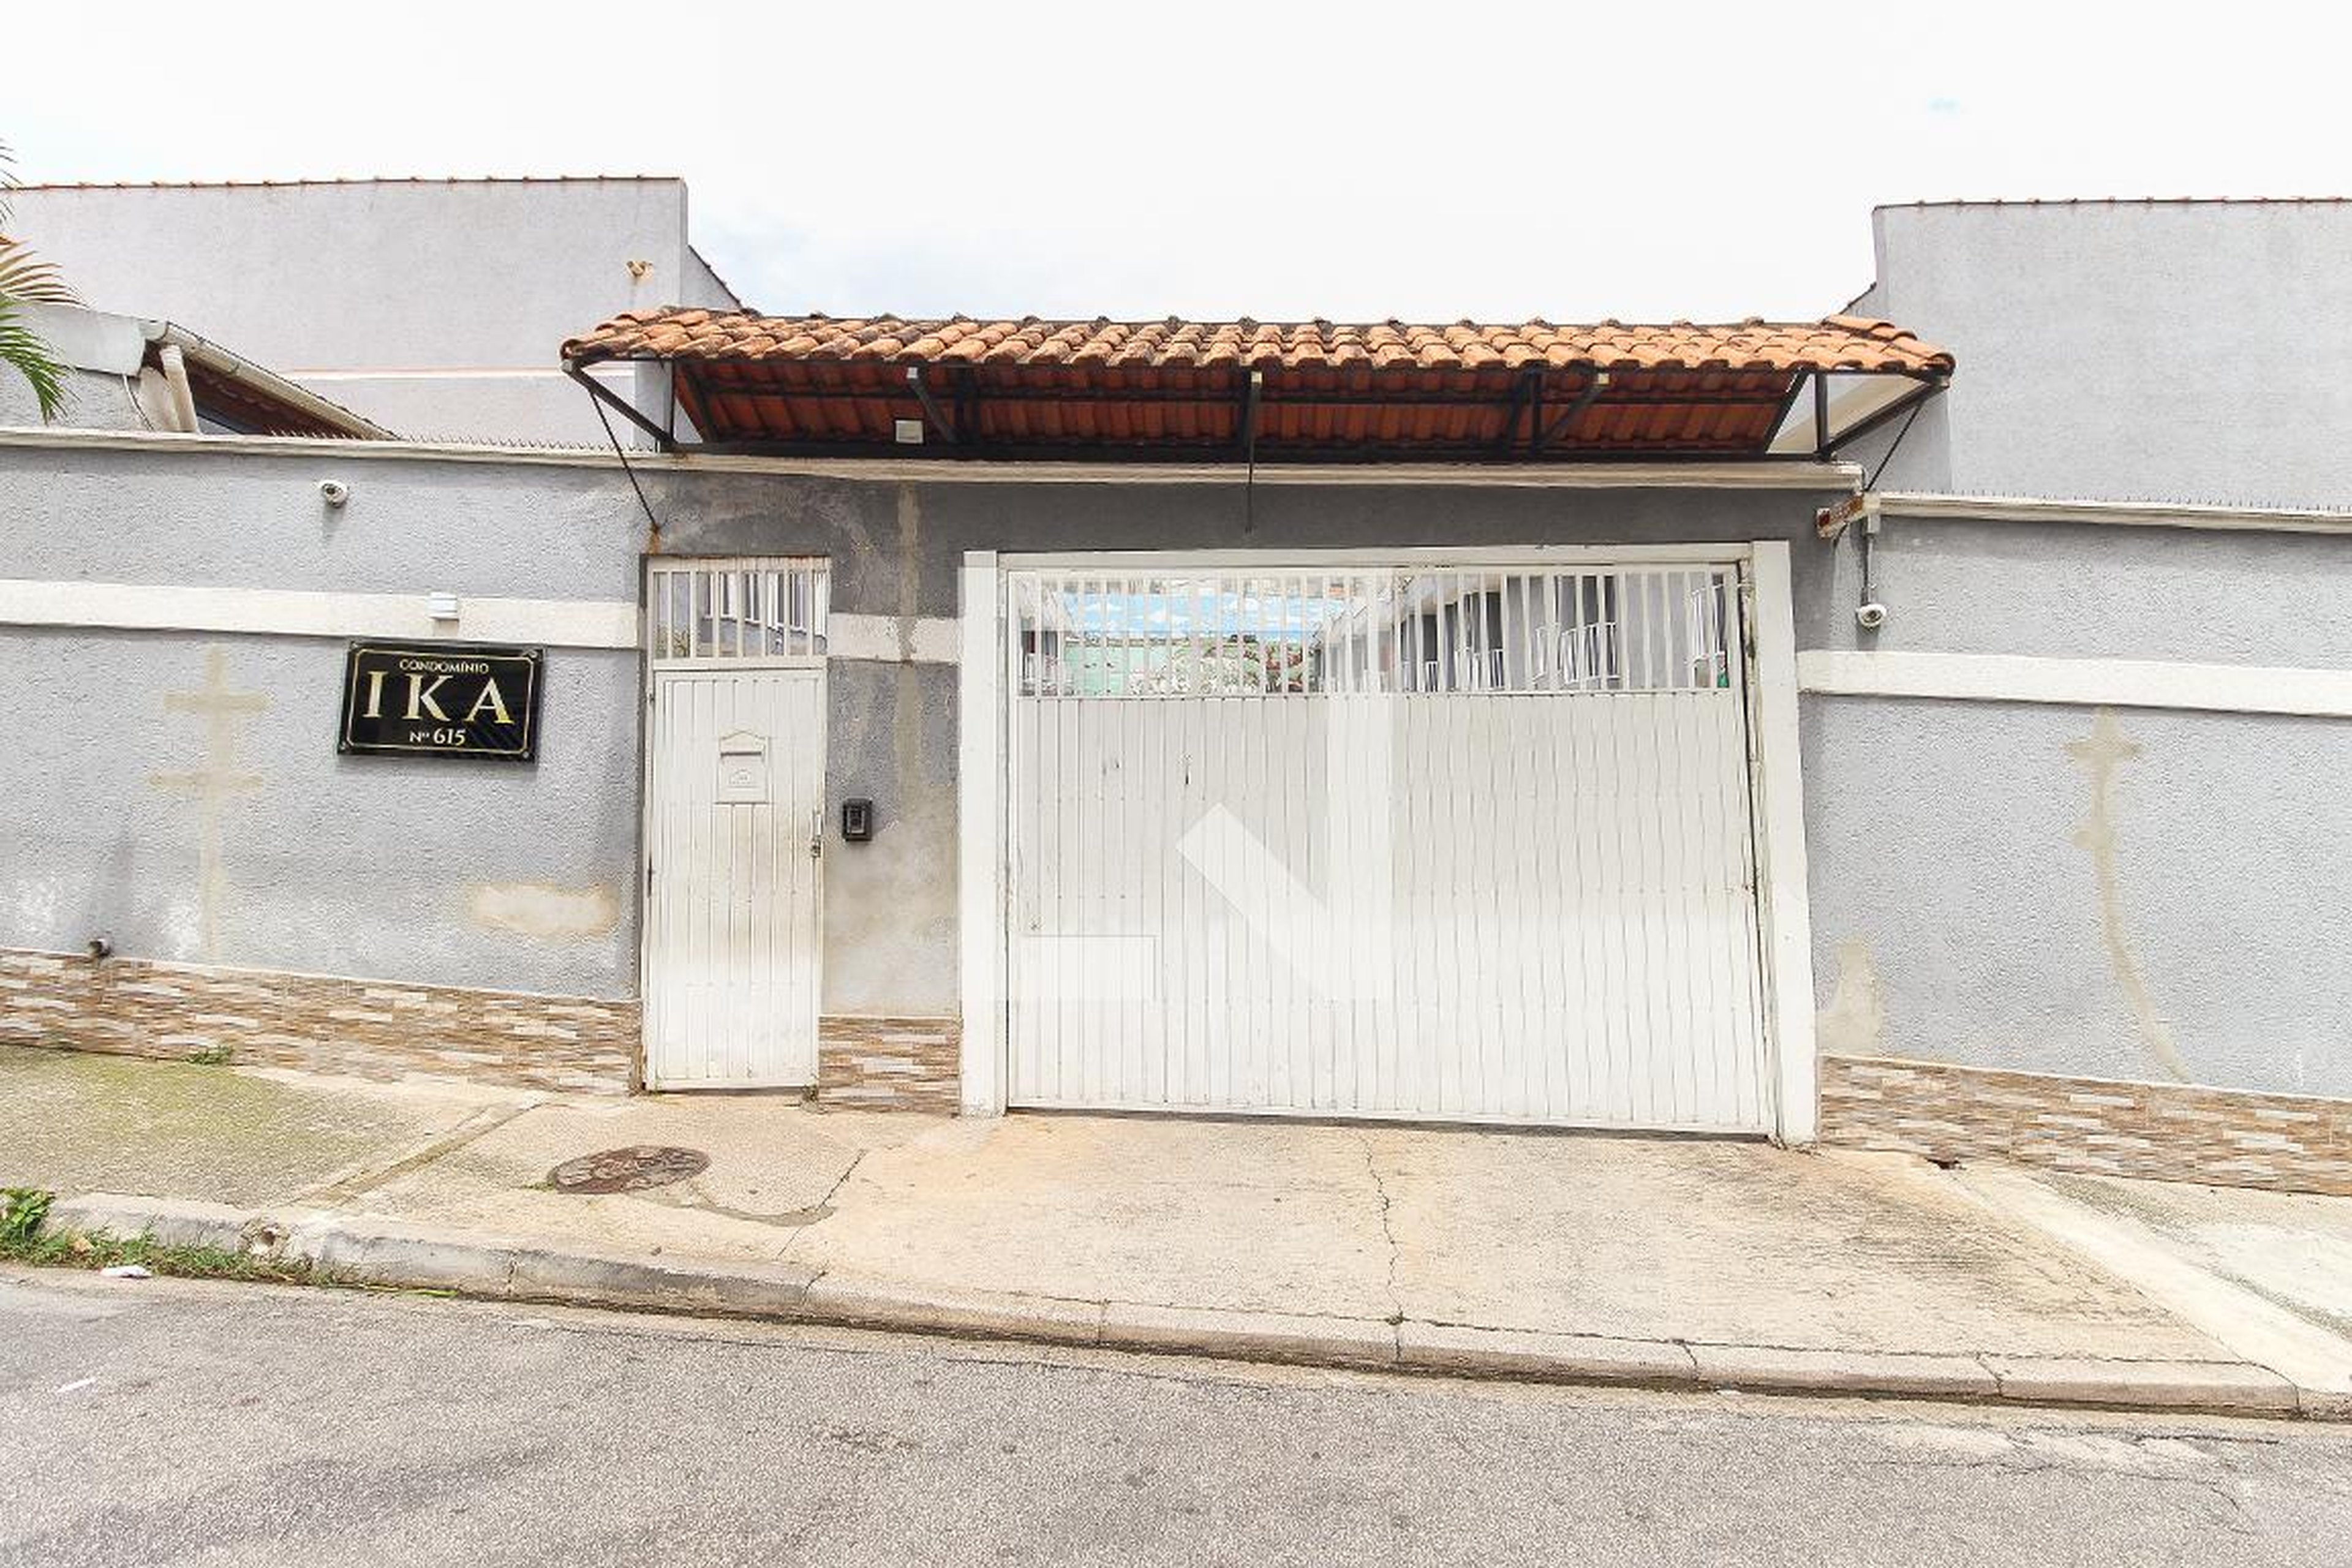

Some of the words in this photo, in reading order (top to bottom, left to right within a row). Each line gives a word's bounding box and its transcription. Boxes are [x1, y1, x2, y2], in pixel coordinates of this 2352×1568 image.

[399, 658, 489, 674] CONDOMÍNIO
[363, 671, 515, 724] IKA
[434, 728, 466, 745] 615
